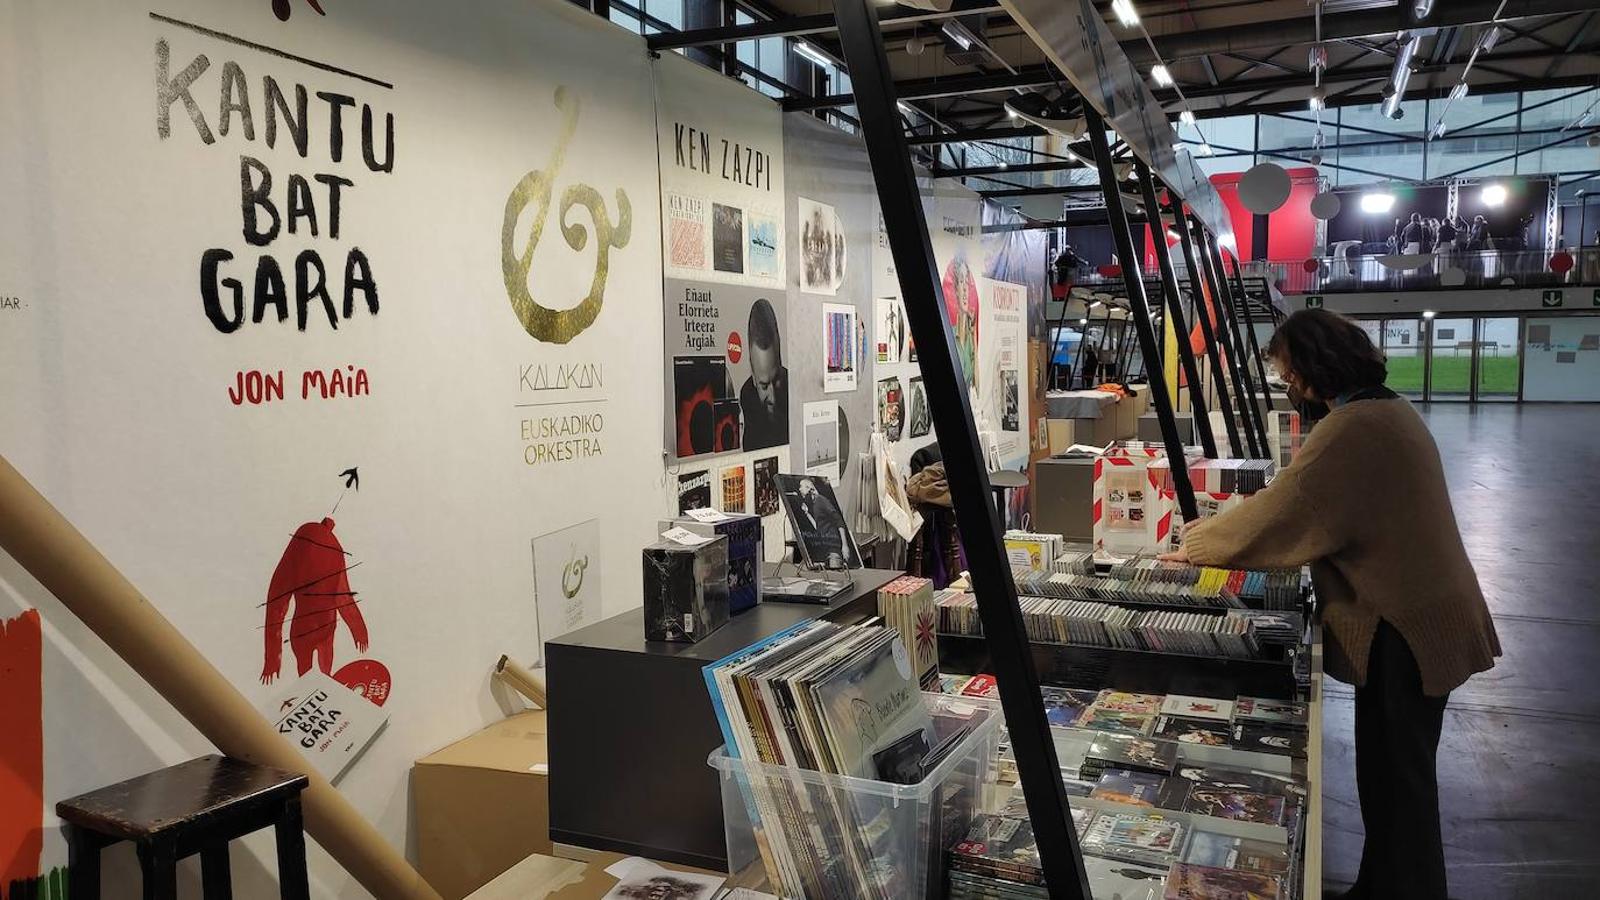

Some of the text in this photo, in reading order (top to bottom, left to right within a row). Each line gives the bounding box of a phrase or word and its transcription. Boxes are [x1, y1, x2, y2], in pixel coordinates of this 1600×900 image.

[153, 37, 395, 174] KANTU
[674, 122, 771, 192] KEN ZAZPI
[239, 154, 354, 247] BAT
[199, 246, 380, 334] GARA
[685, 287, 713, 303] Eñaut
[679, 303, 720, 318] Elorrieta
[684, 318, 716, 333] Irteera
[685, 333, 716, 351] Argiak
[228, 370, 284, 406] JON
[519, 363, 603, 392] KALAKAN
[520, 413, 604, 441] EUSKADIKO
[523, 438, 603, 466] ORKESTRA
[298, 706, 324, 734] BAT
[300, 709, 342, 748] GARA
